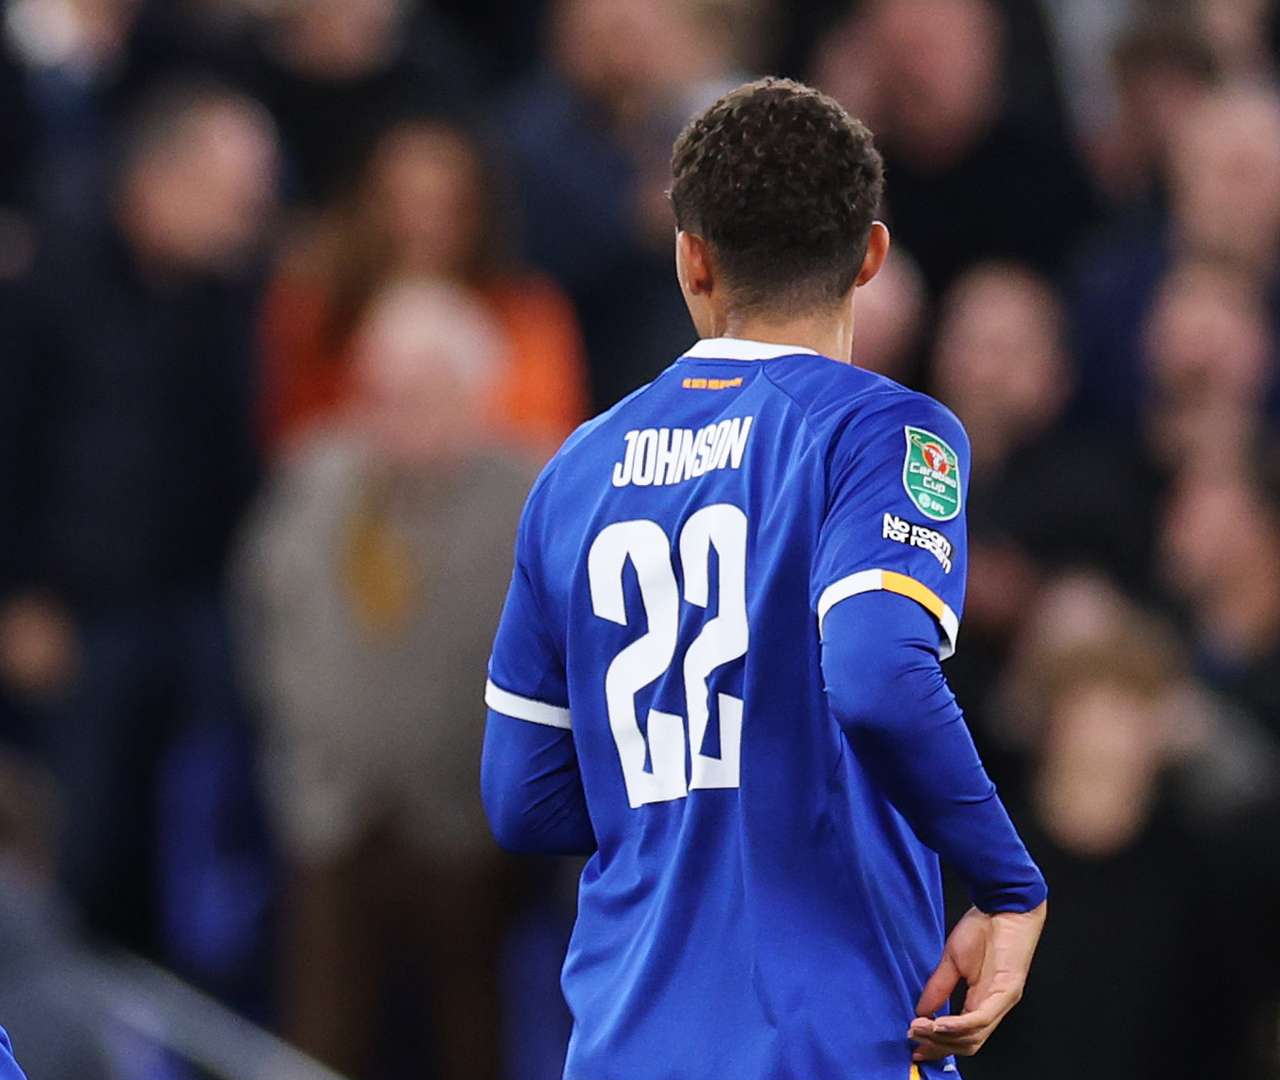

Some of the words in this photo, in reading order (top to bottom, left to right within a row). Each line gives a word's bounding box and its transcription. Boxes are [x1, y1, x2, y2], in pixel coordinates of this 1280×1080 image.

[612, 415, 753, 488] JOHNSON
[923, 476, 946, 494] Cup
[882, 512, 910, 533] No
[911, 524, 952, 558] room
[882, 527, 909, 544] for
[587, 503, 749, 808] 22
